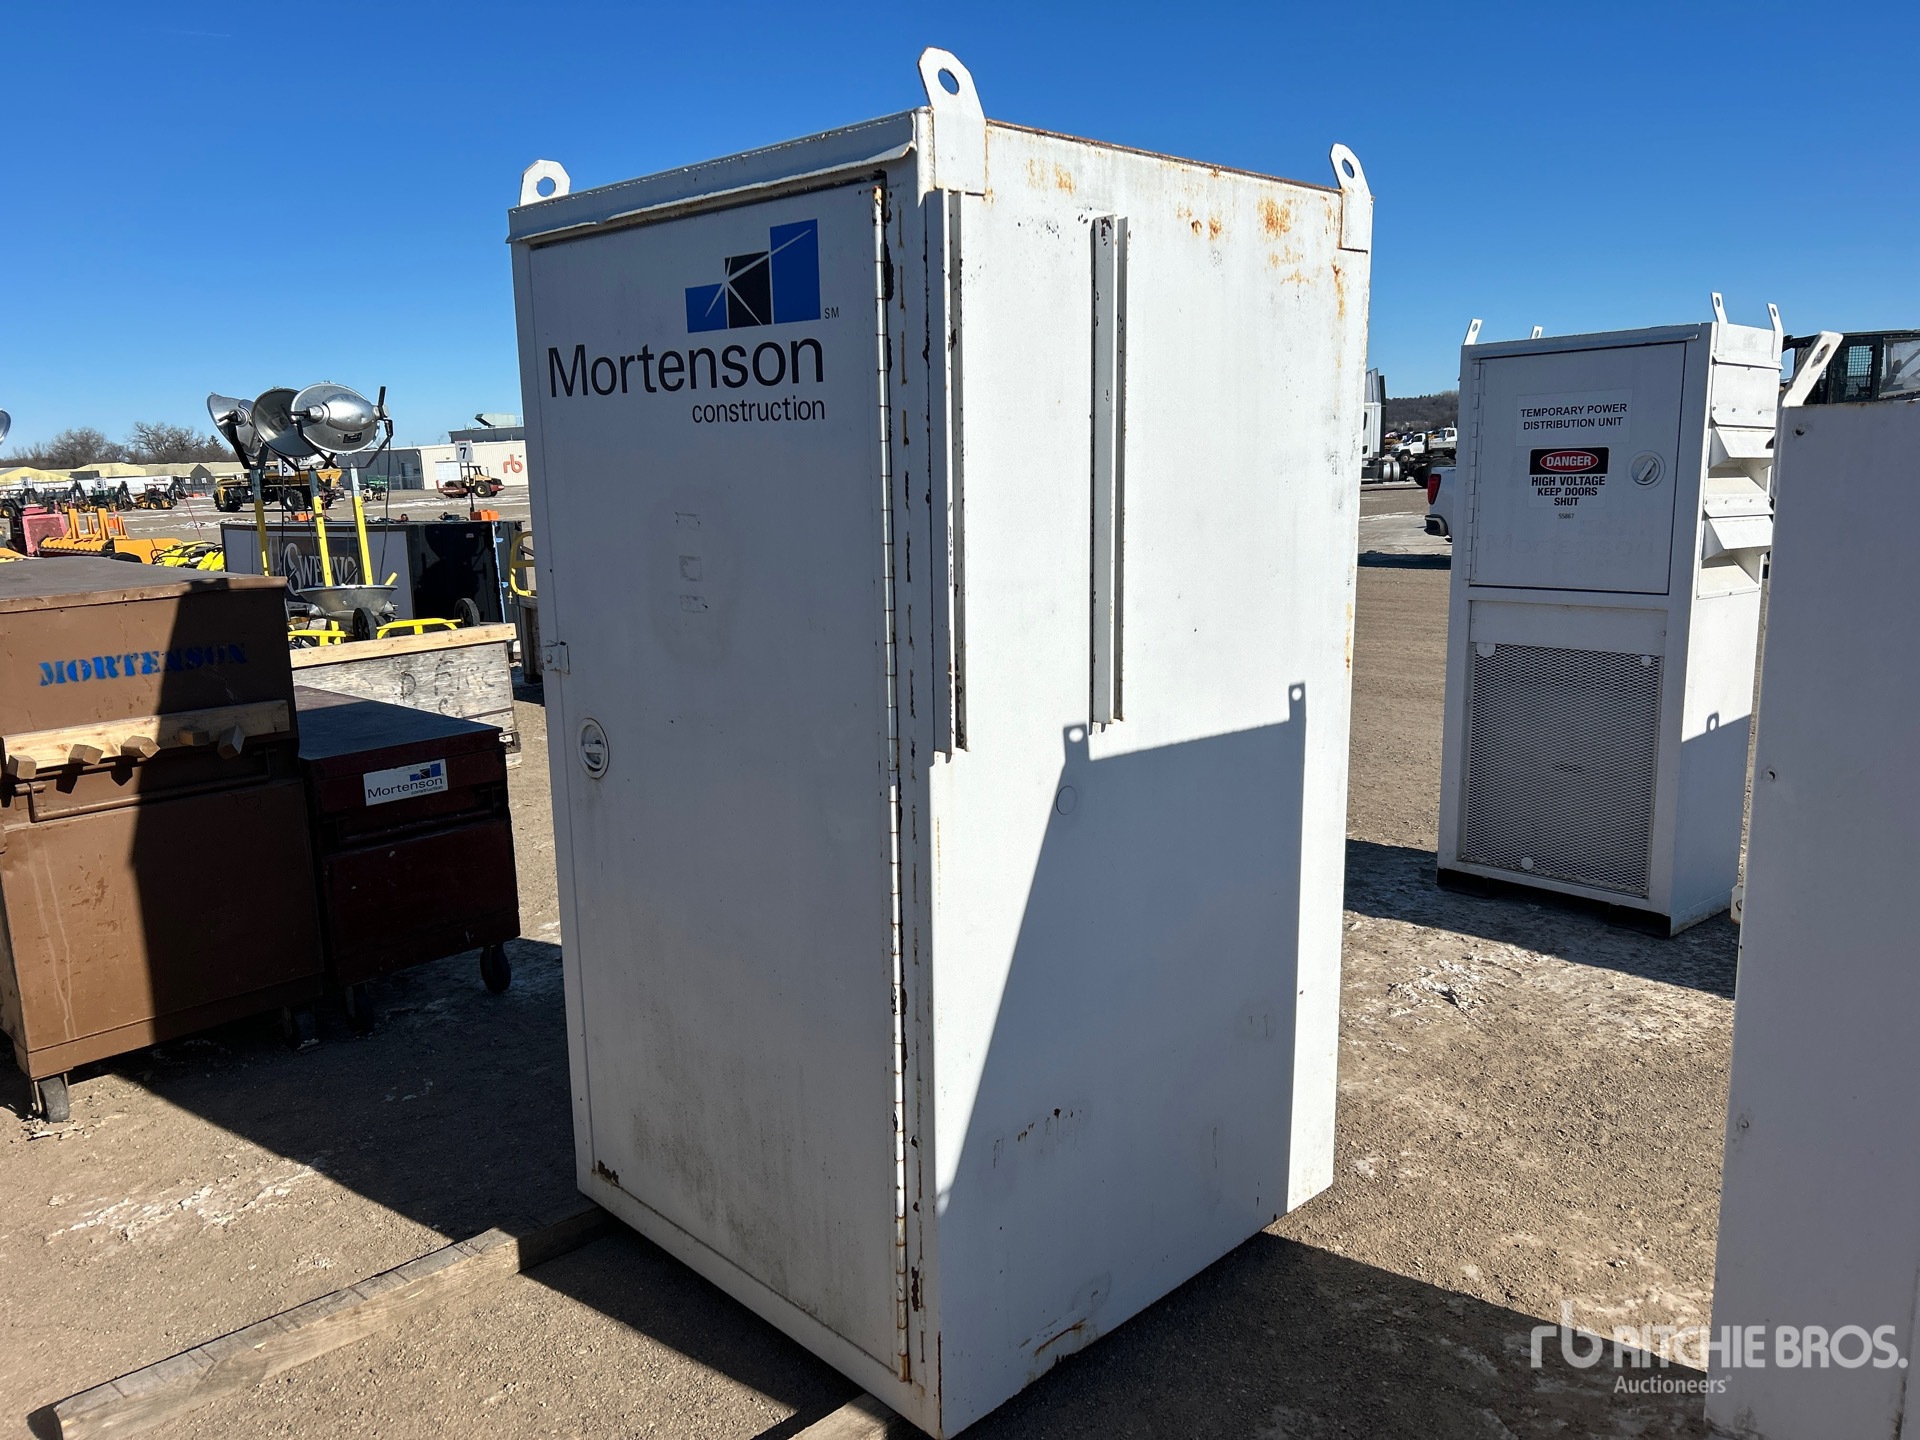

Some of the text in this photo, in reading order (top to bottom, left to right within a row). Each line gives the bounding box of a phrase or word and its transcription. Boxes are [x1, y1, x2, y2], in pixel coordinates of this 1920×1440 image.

[824, 306, 840, 319] SM
[548, 337, 824, 398] Mortenson
[692, 395, 826, 423] construction
[1520, 403, 1627, 418] TEMPORARY POWER
[1523, 416, 1624, 430] DISTRIBUTION UNIT
[459, 446, 467, 460] 7
[503, 454, 523, 473] rb
[1546, 455, 1592, 467] DANGER
[1531, 475, 1606, 486] HIGH VOLTAGE
[1537, 487, 1598, 496] KEEP DOORS
[1553, 497, 1580, 506] SHUT
[39, 643, 248, 687] MORTENSON
[367, 777, 443, 799] Mortenson
